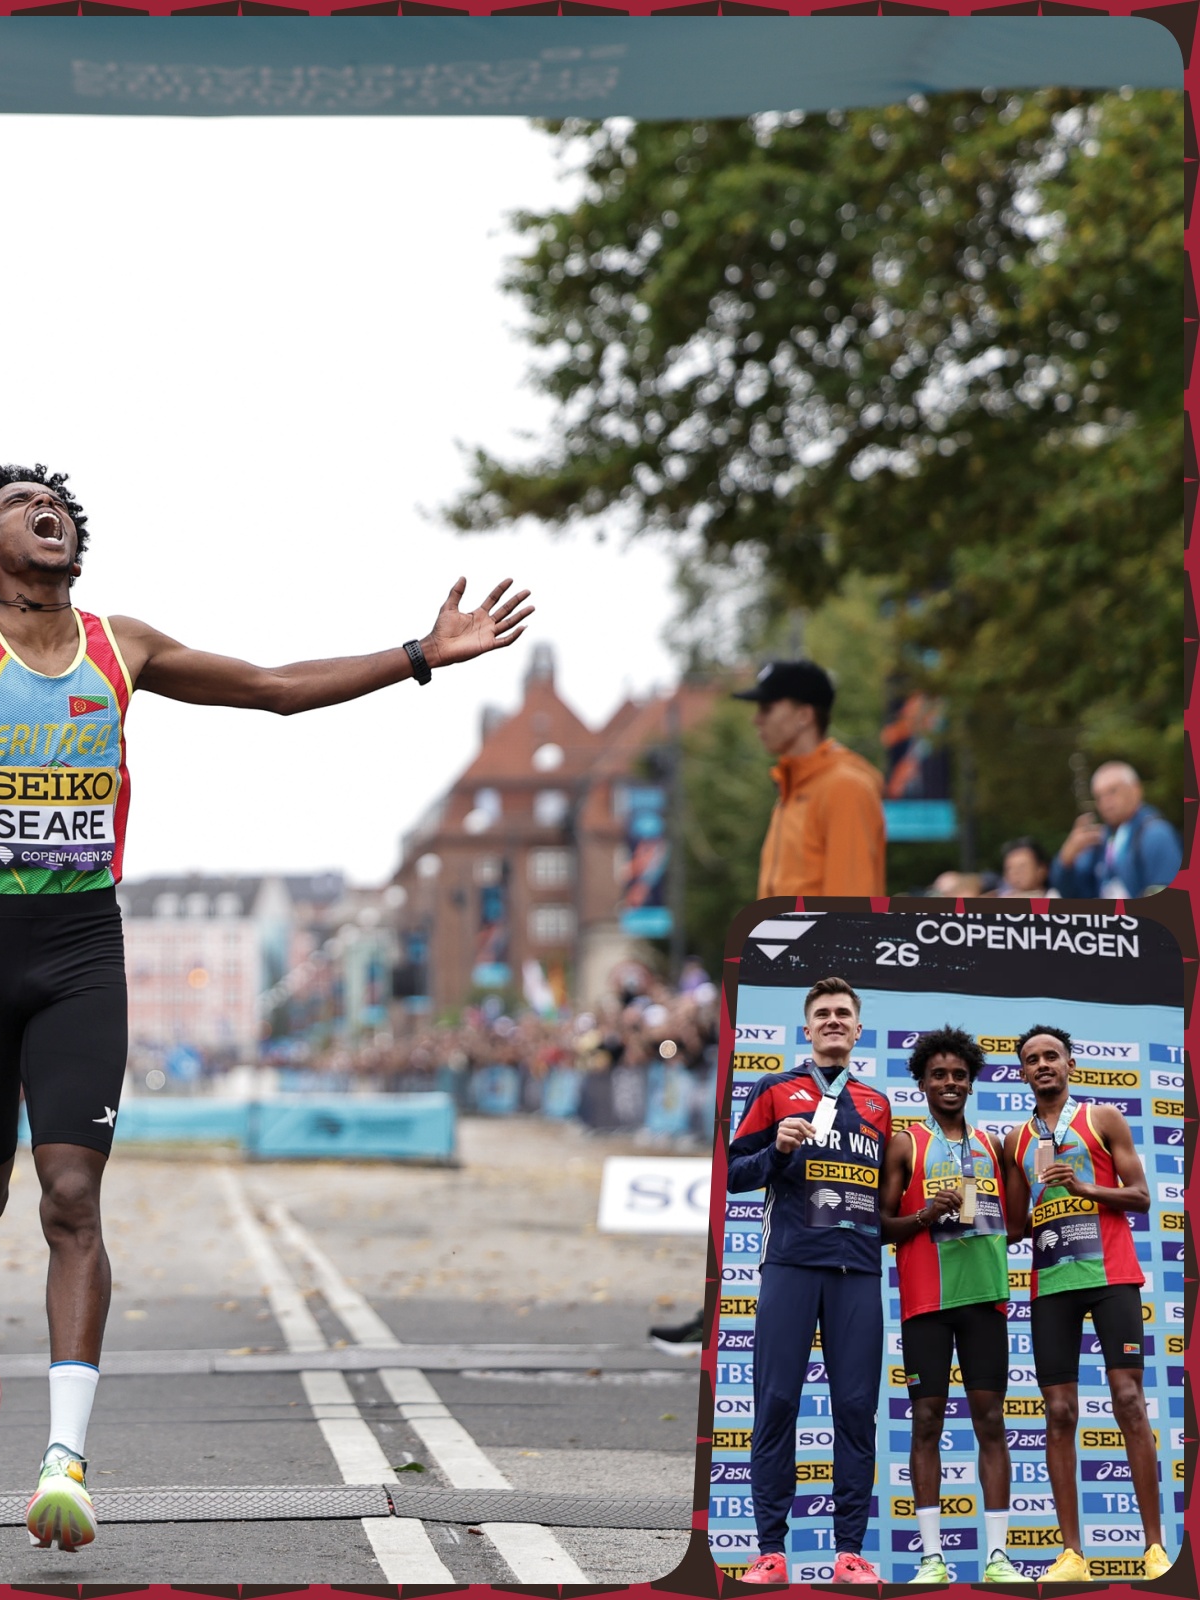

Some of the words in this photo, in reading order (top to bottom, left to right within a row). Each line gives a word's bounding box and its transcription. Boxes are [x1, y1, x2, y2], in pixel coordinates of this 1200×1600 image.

[21, 850, 99, 863] COPENHAGEN
[101, 850, 113, 864] 26
[916, 920, 1139, 958] COPENHAGEN
[875, 942, 920, 967] 26
[735, 1028, 777, 1040] ONY
[1072, 1043, 1131, 1057] SONY
[1069, 1070, 1138, 1086] SEIKO
[1157, 1076, 1184, 1087] SO
[894, 1090, 927, 1102] SO
[997, 1093, 1036, 1111] TBS
[849, 1132, 879, 1161] WAY
[808, 1163, 876, 1184] SEIKO
[728, 1205, 764, 1218] asics
[1034, 1197, 1095, 1223] SEIKO
[724, 1233, 760, 1252] TBS
[720, 1299, 757, 1314] EIK
[725, 1334, 754, 1347] asic
[1009, 1334, 1031, 1353] TB
[717, 1363, 753, 1383] TBS
[713, 1431, 752, 1447] EIK
[800, 1432, 832, 1446] SO
[1018, 1432, 1046, 1446] asic
[1083, 1430, 1125, 1447] SEI
[898, 1467, 966, 1480] SNY
[1012, 1462, 1049, 1482] TBS
[712, 1497, 754, 1517] TBS
[1102, 1493, 1139, 1513] TBS
[1092, 1529, 1141, 1542] SON
[801, 1566, 833, 1580] SO
[1090, 1560, 1146, 1576] SEIK
